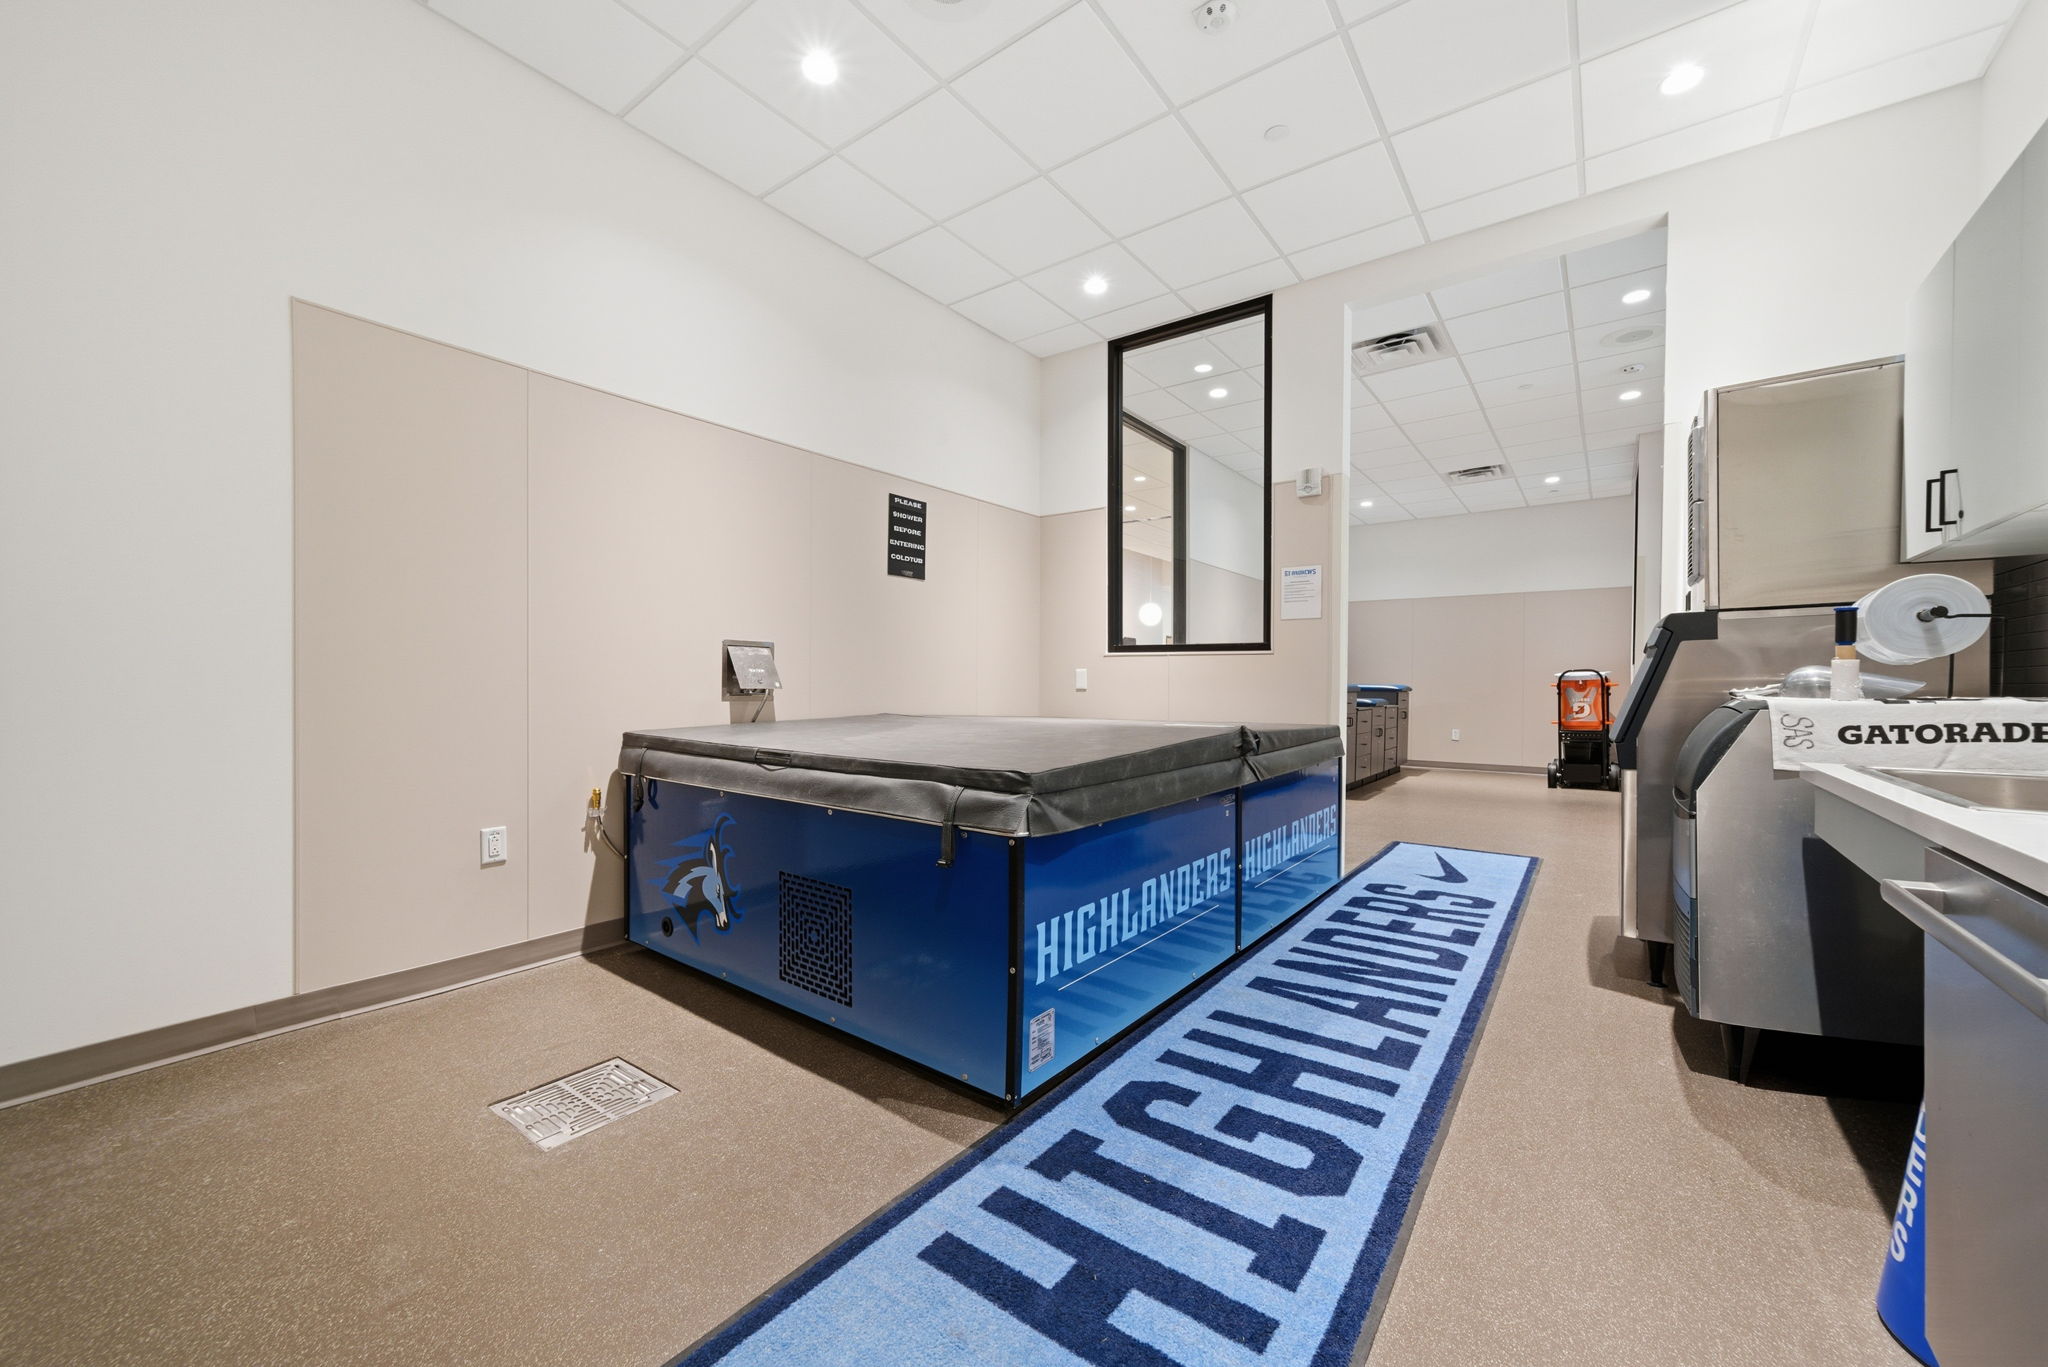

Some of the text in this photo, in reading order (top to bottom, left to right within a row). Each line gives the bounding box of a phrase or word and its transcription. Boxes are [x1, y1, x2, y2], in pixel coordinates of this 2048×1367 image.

[894, 497, 922, 509] PLEASE
[892, 511, 923, 523] SHOWER
[893, 525, 922, 537] BEFORE
[889, 539, 925, 551] ENTERING
[890, 553, 923, 564] COLDTUB
[1838, 722, 2048, 744] GATORADE
[1245, 804, 1337, 882] HIGHLANDERS
[1036, 848, 1231, 985] HIGHLANDERS
[917, 883, 1497, 1367] HIGHLANDERS
